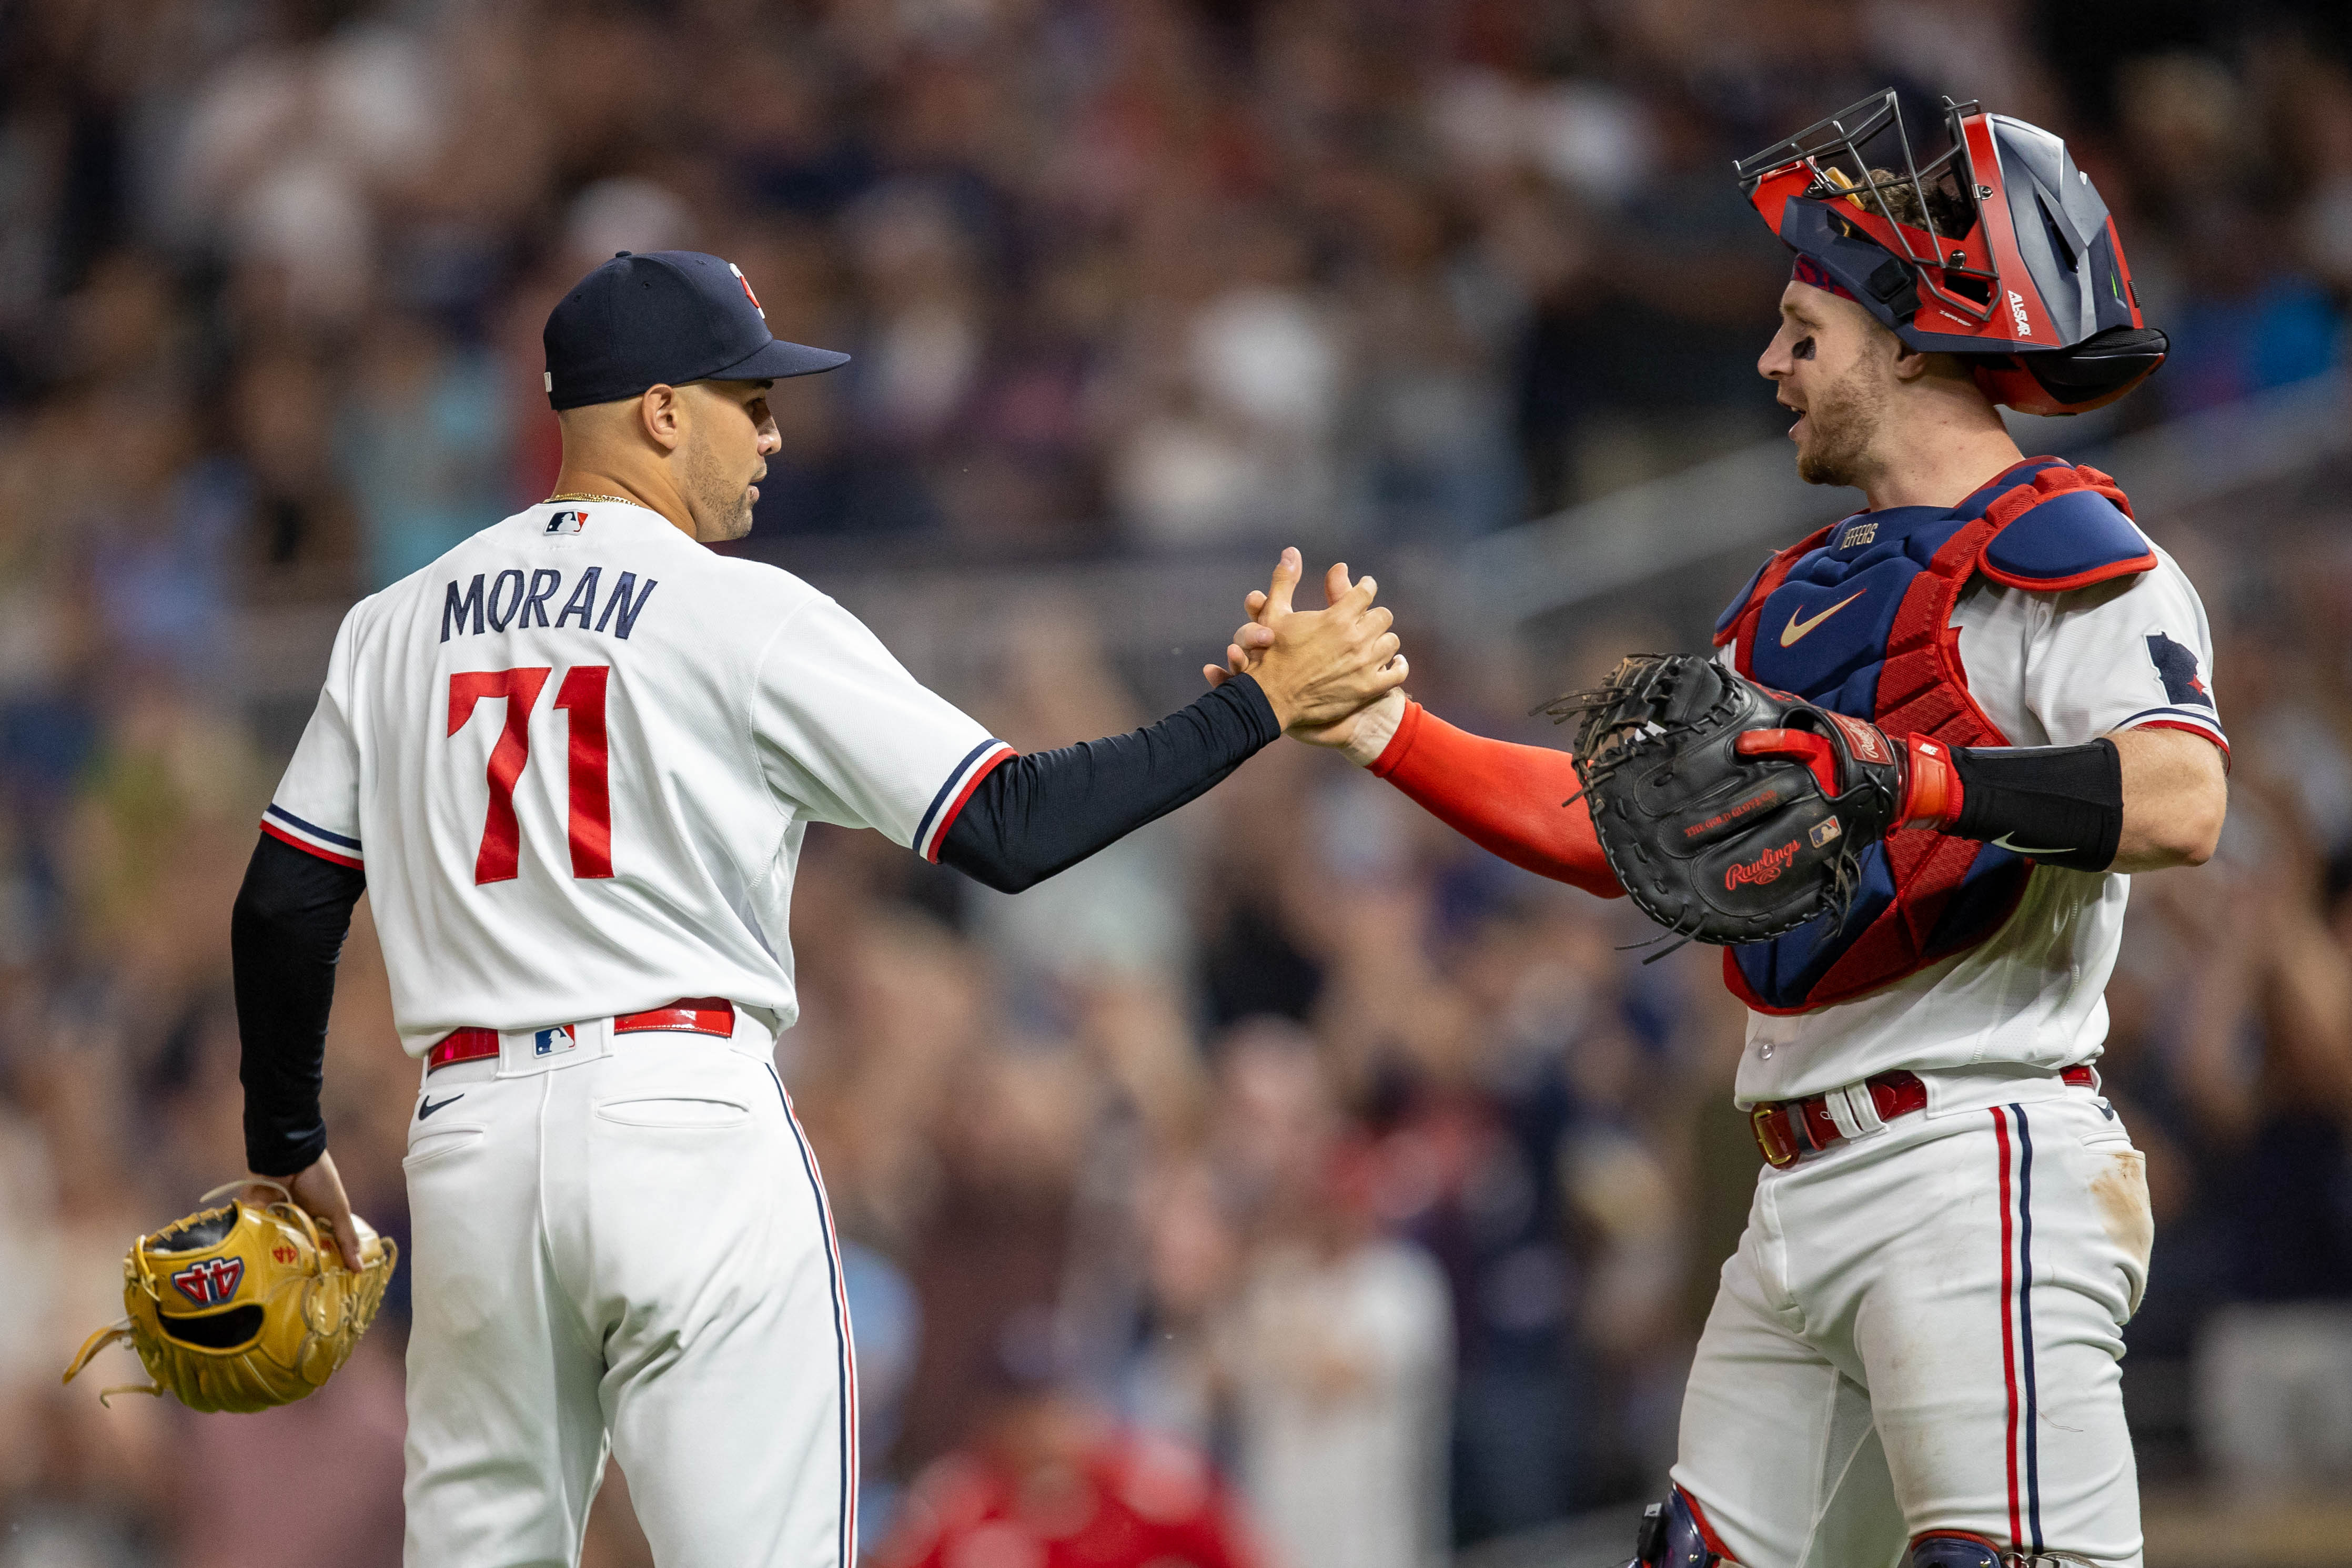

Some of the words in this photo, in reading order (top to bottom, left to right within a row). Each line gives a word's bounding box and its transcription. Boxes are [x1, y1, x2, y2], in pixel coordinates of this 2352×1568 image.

[2007, 290, 2031, 337] ALL-STAR
[440, 566, 658, 644] MORAN
[447, 665, 614, 885] 71
[1919, 743, 1939, 755] NIKE
[1725, 839, 1801, 891] Rawlings
